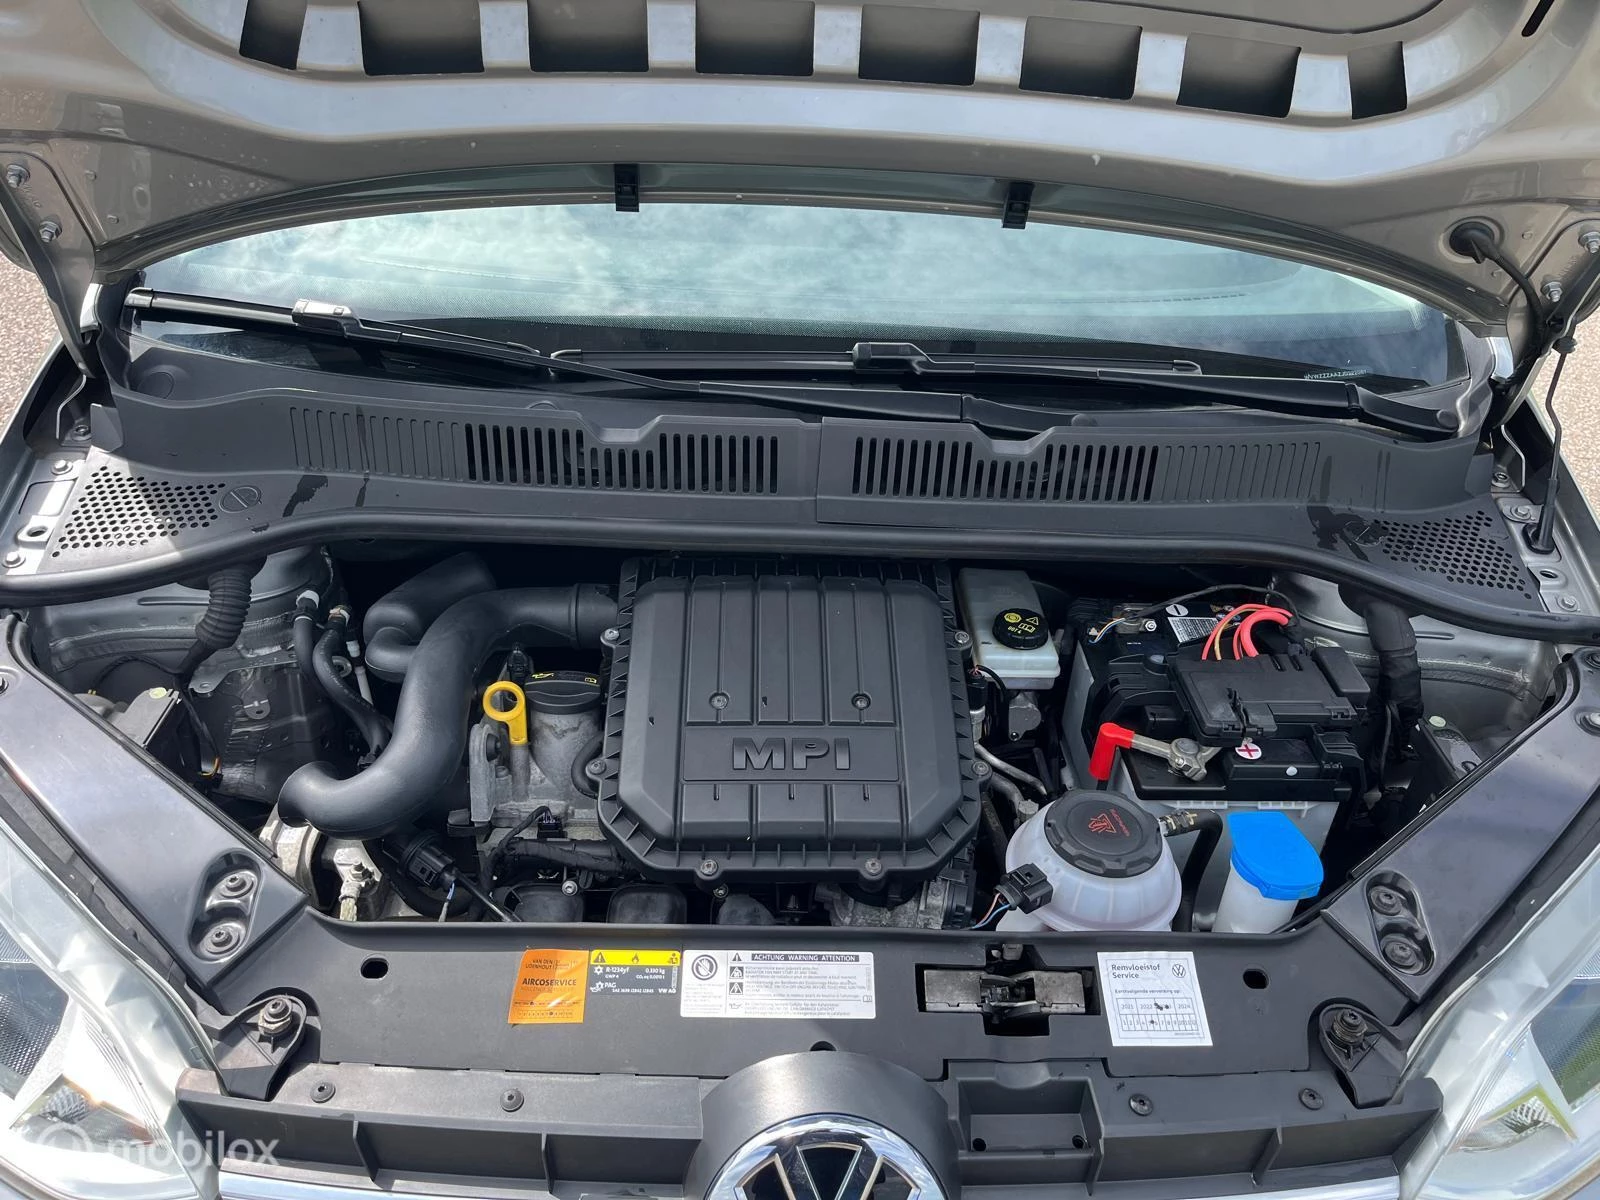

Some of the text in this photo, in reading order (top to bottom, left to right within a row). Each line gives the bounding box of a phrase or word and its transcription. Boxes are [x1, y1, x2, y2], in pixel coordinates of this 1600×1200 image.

[732, 737, 851, 771] MPI
[605, 966, 630, 975] R-1234yf
[658, 967, 666, 975] kg
[522, 977, 577, 986] AIRCOSERVICE
